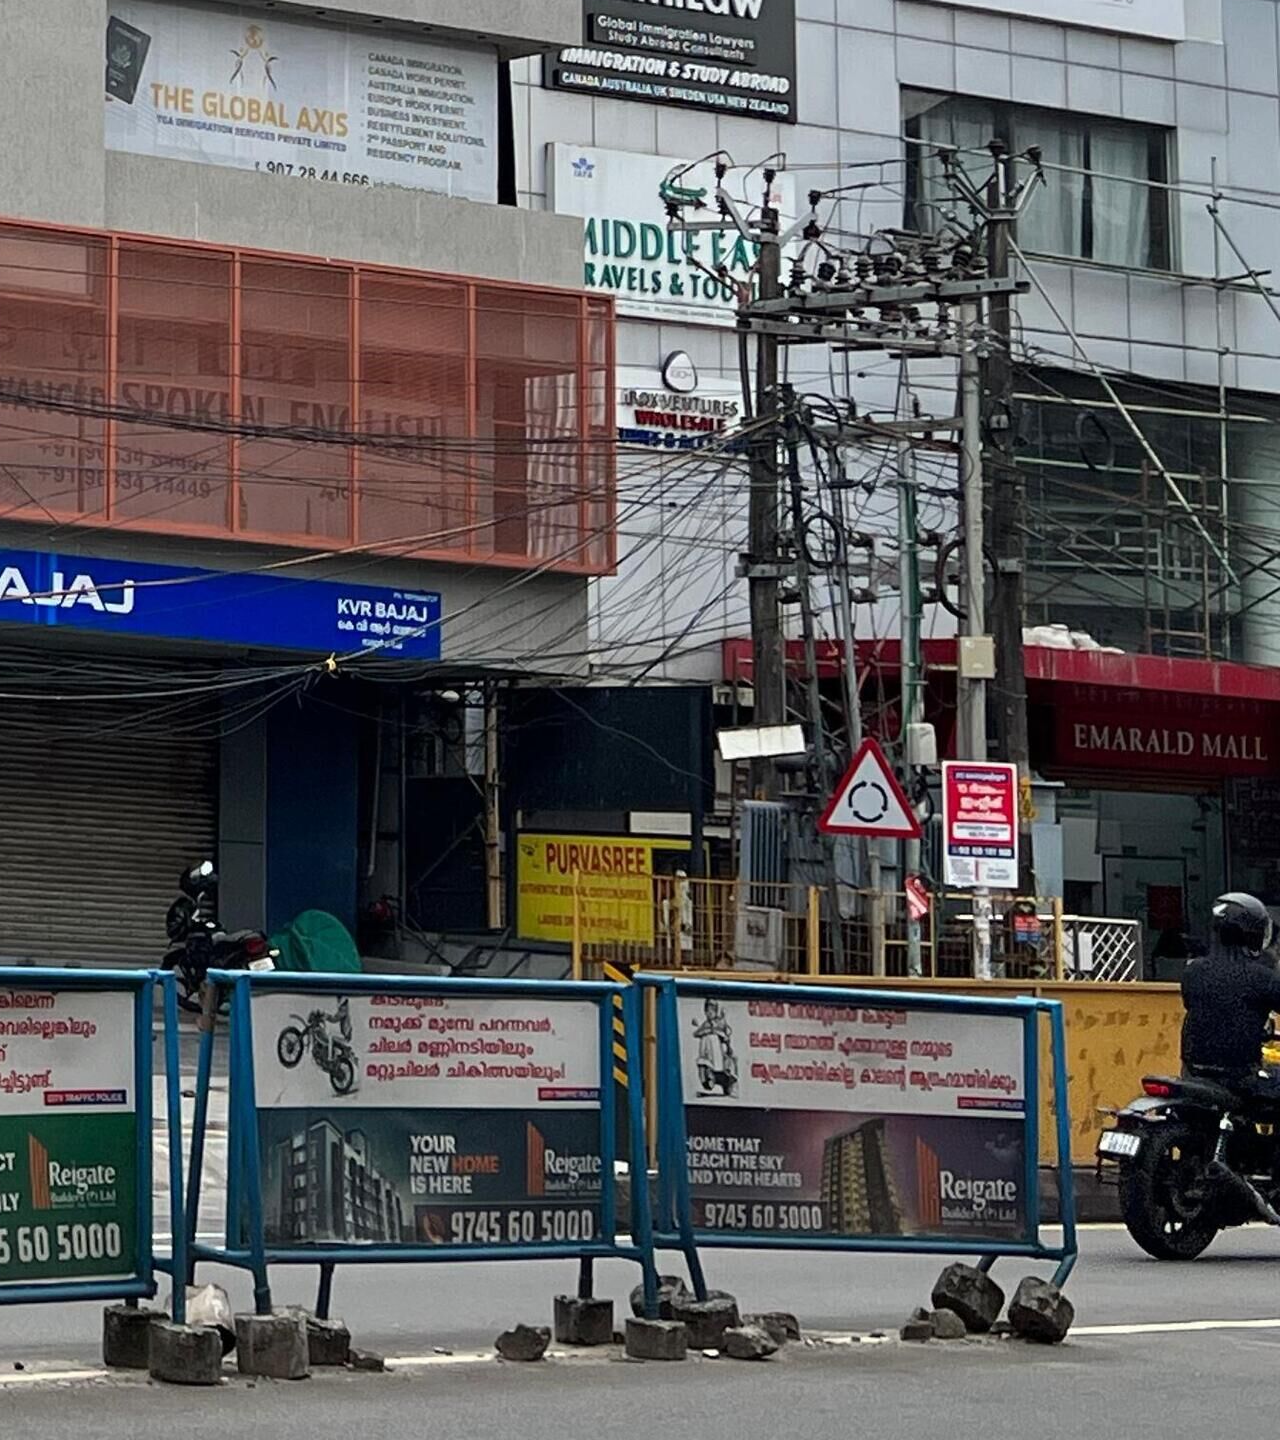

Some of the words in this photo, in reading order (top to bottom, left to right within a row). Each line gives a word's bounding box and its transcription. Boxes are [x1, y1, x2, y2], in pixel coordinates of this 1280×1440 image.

[597, 15, 637, 33] Global
[639, 21, 708, 44] Immigration
[709, 33, 755, 50] Lawyers
[608, 31, 638, 45] Study
[639, 37, 680, 51] Abroad
[682, 42, 745, 60] Consultants
[560, 47, 667, 76] IMMIGRATION
[668, 62, 681, 77] &
[682, 64, 730, 85] STUDY
[728, 71, 790, 95] ABROAD
[562, 72, 600, 87] CANADA
[601, 78, 652, 95] AUSTRALIA
[669, 89, 706, 103] SWEDEN
[708, 93, 725, 106] USA
[749, 98, 789, 115] ZEALAND
[150, 83, 194, 114] THE
[202, 92, 290, 129] GLOBAL
[296, 107, 349, 138] AXIS
[585, 263, 662, 296] RAVELS
[669, 273, 684, 296] &
[337, 598, 372, 616] KVR
[374, 601, 428, 623] BAJAJ
[1073, 723, 1194, 756] EMARALD
[1202, 733, 1268, 761] MALL
[545, 843, 646, 875] PURVASREE
[410, 1136, 456, 1154] YOUR
[726, 1138, 761, 1152] THAT
[49, 1161, 116, 1195] Reigate
[410, 1156, 448, 1174] NEW
[452, 1156, 499, 1173] HOME
[544, 1148, 602, 1183] Reigate
[731, 1154, 757, 1169] THE
[758, 1155, 784, 1170] SKY
[411, 1176, 426, 1194] IS
[429, 1176, 472, 1194] HERE
[715, 1171, 753, 1186] YOUR
[754, 1173, 802, 1187] HEARTS
[940, 1171, 1016, 1210] Reigate
[451, 1211, 501, 1244] 9745
[508, 1211, 534, 1242] 60
[542, 1210, 593, 1241] 5000
[705, 1204, 747, 1228] 9745
[752, 1205, 773, 1228] 60
[779, 1205, 822, 1229] 5000
[17, 1226, 50, 1262] 60
[56, 1222, 121, 1260] 5000
